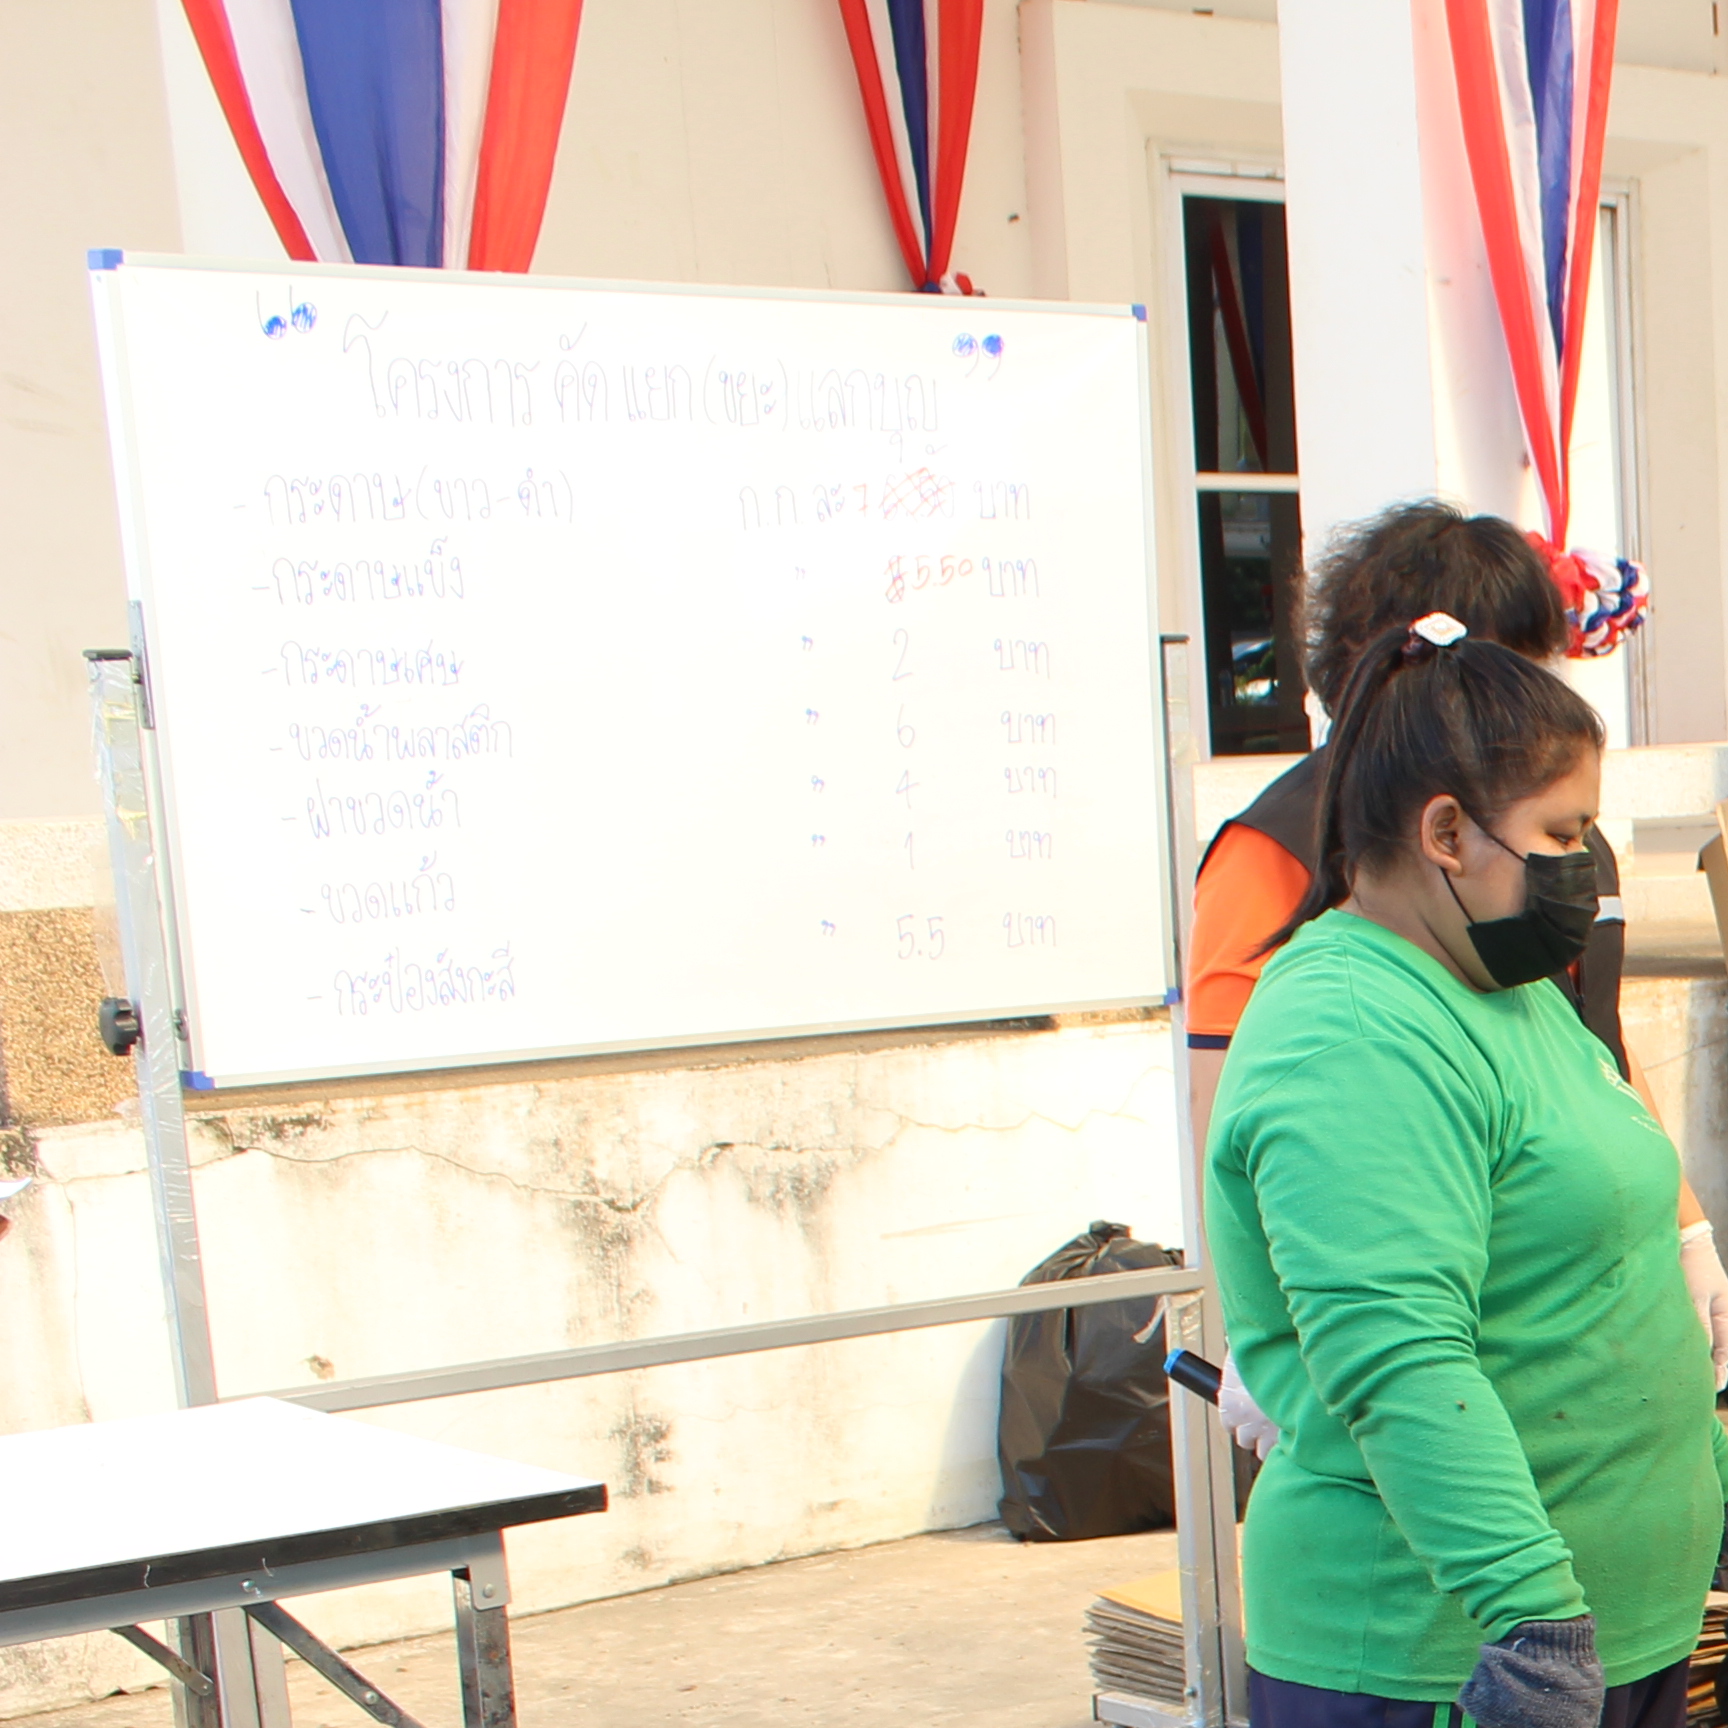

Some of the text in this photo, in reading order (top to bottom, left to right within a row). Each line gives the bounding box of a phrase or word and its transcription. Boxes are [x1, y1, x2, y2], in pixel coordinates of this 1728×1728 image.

[972, 479, 1031, 521] บาท
[981, 555, 1040, 598] บาท
[892, 627, 915, 683] 2
[993, 637, 1051, 681] บาท
[895, 702, 916, 749] 6
[1000, 710, 1056, 746] บาท
[894, 768, 921, 810] 4
[1003, 765, 1057, 800] บาท
[1005, 827, 1053, 861] บาท
[1002, 911, 1058, 949] บาท
